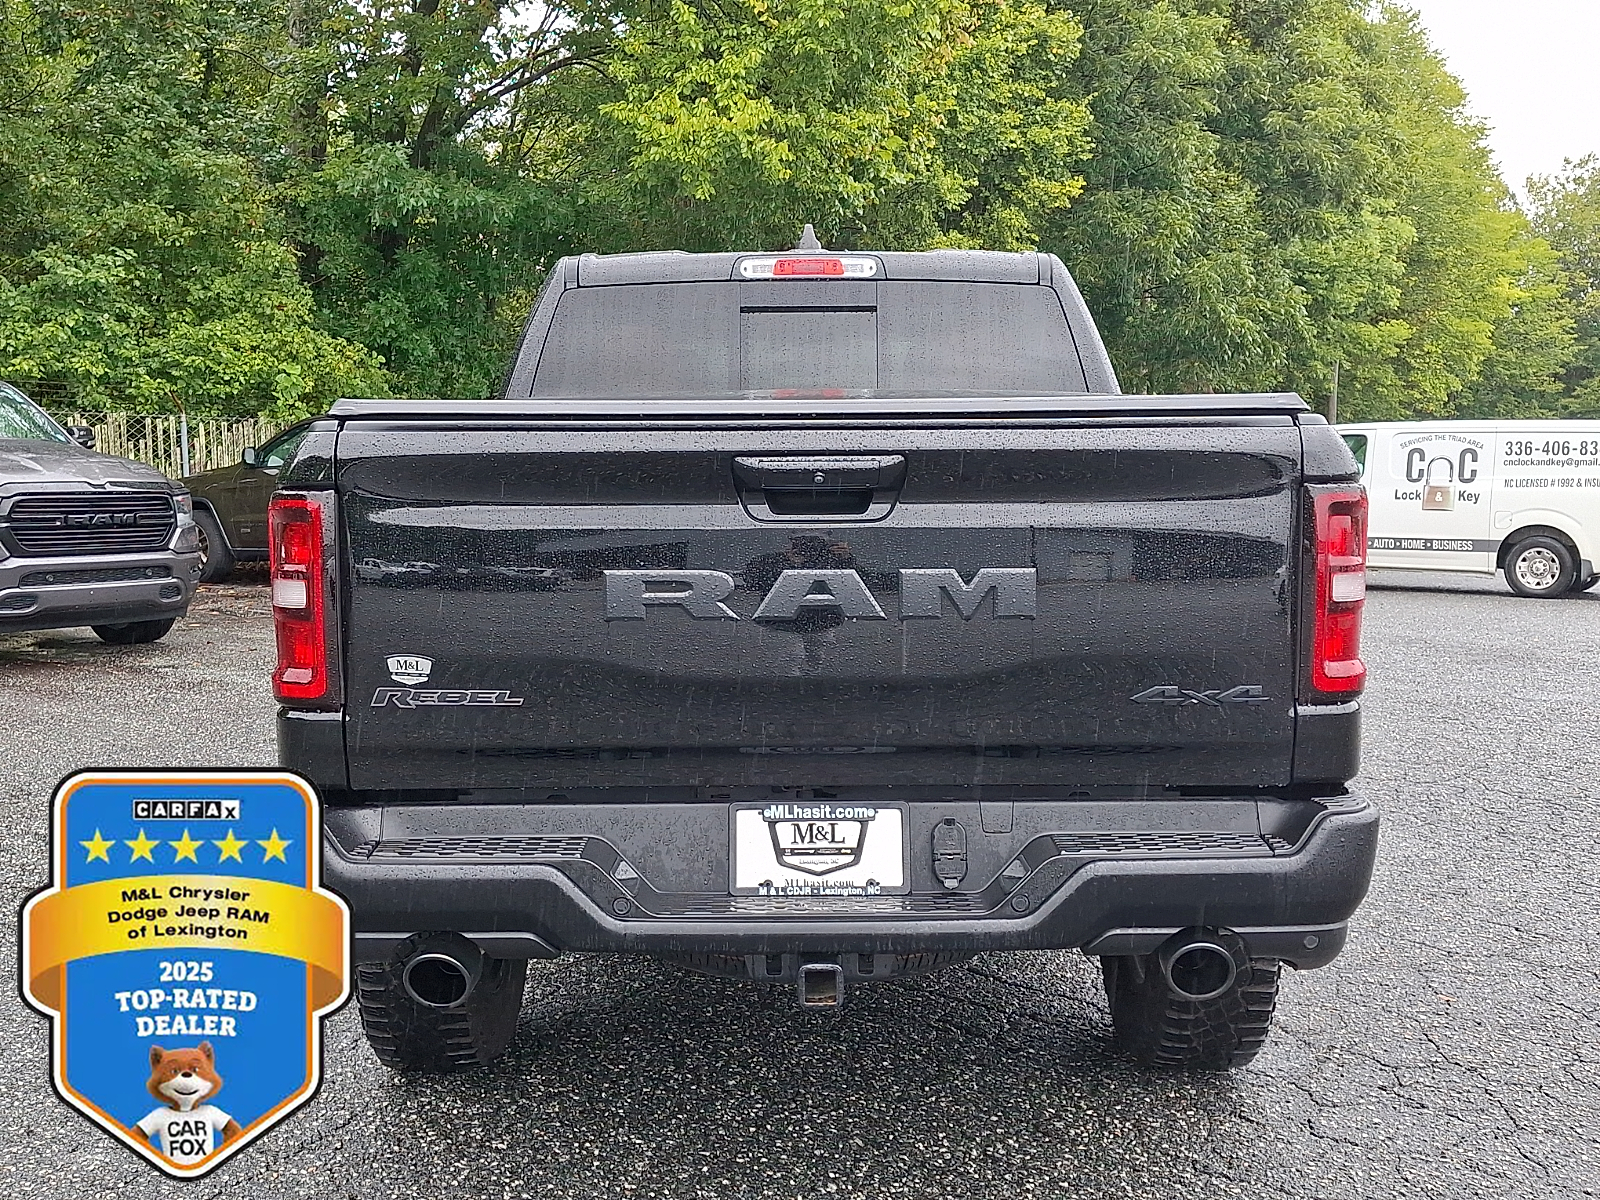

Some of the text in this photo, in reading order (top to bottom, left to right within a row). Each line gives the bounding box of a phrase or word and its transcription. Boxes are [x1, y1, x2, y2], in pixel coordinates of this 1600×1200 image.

[1400, 435, 1433, 449] SERVICING
[1448, 435, 1467, 443] TRIAD
[1467, 439, 1484, 450] AREA
[1504, 441, 1600, 456] 336-406-83
[1406, 447, 1478, 484] C C
[1504, 478, 1514, 488] NC
[1515, 478, 1549, 488] LICENSED
[1576, 478, 1583, 488] &
[1394, 489, 1480, 504] Lock & Key
[1373, 539, 1473, 551] AUTO HOME BUSINESS
[602, 567, 1038, 621] RAM
[395, 659, 424, 671] M&L
[370, 687, 525, 709] REBEL
[771, 804, 868, 820] MLhasit.com
[791, 822, 845, 845] M&L
[758, 887, 767, 895] M
[779, 887, 785, 895] L
[786, 887, 812, 895] CDJR
[820, 886, 865, 896] Lexington,
[867, 886, 881, 895] NC
